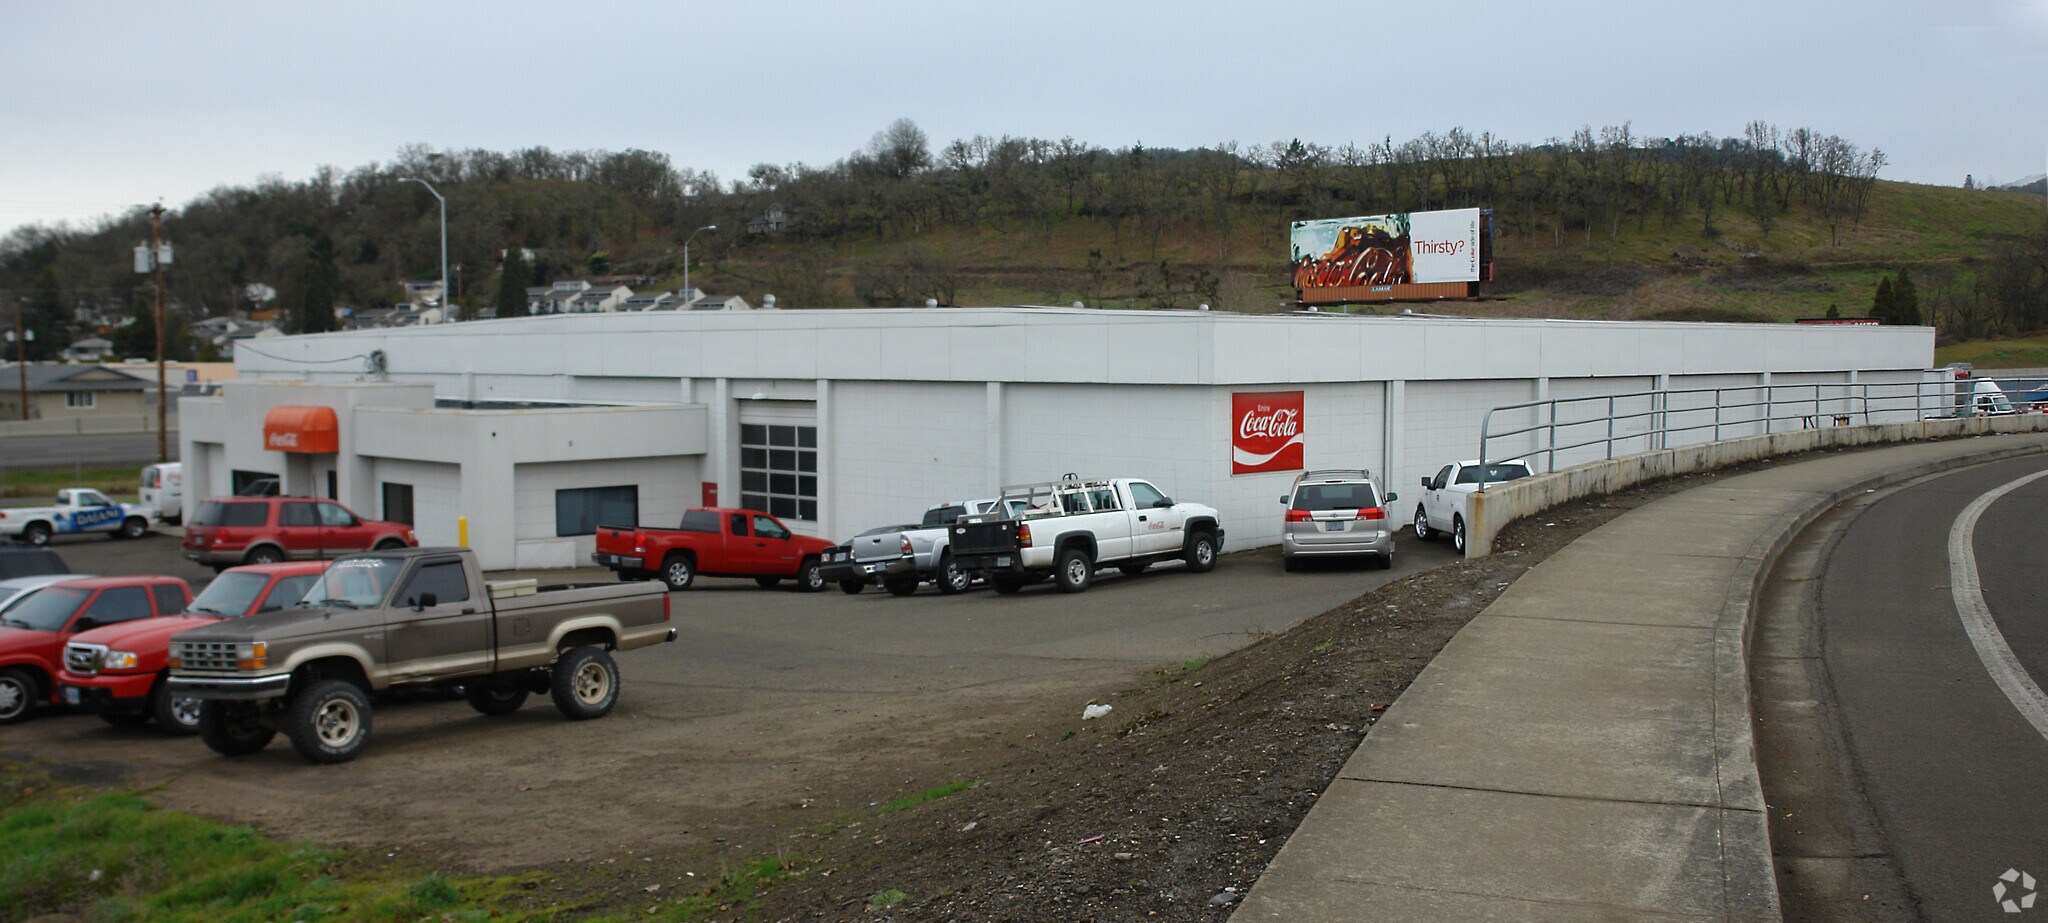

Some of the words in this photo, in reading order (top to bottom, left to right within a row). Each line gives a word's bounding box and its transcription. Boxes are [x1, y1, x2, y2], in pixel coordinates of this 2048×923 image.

[1415, 240, 1465, 256] Thirsty?
[1257, 404, 1271, 413] Enjoy
[1240, 408, 1299, 440] Coca-Cola
